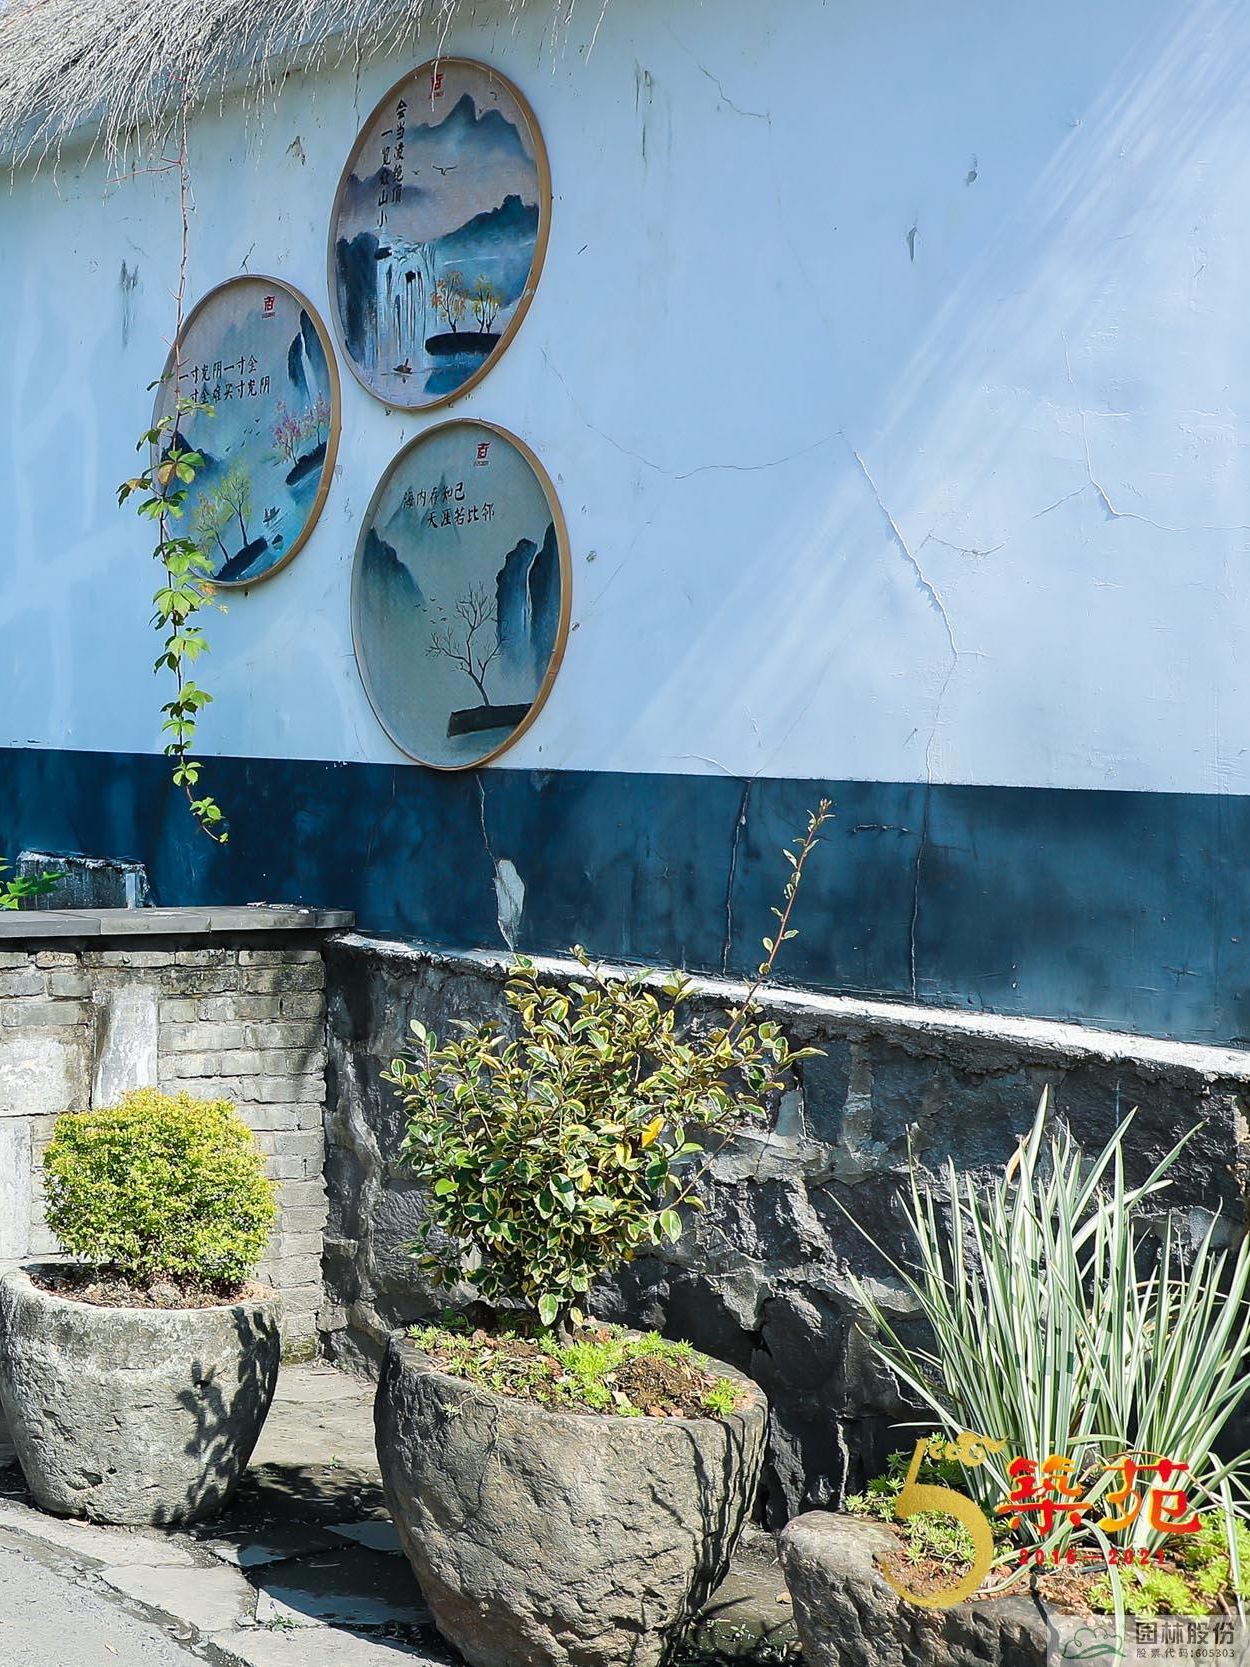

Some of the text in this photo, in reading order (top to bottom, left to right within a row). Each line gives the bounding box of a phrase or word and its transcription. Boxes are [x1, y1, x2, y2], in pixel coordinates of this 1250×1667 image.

[401, 481, 465, 509] 海内存知己
[427, 502, 495, 528] 天涯若比邻
